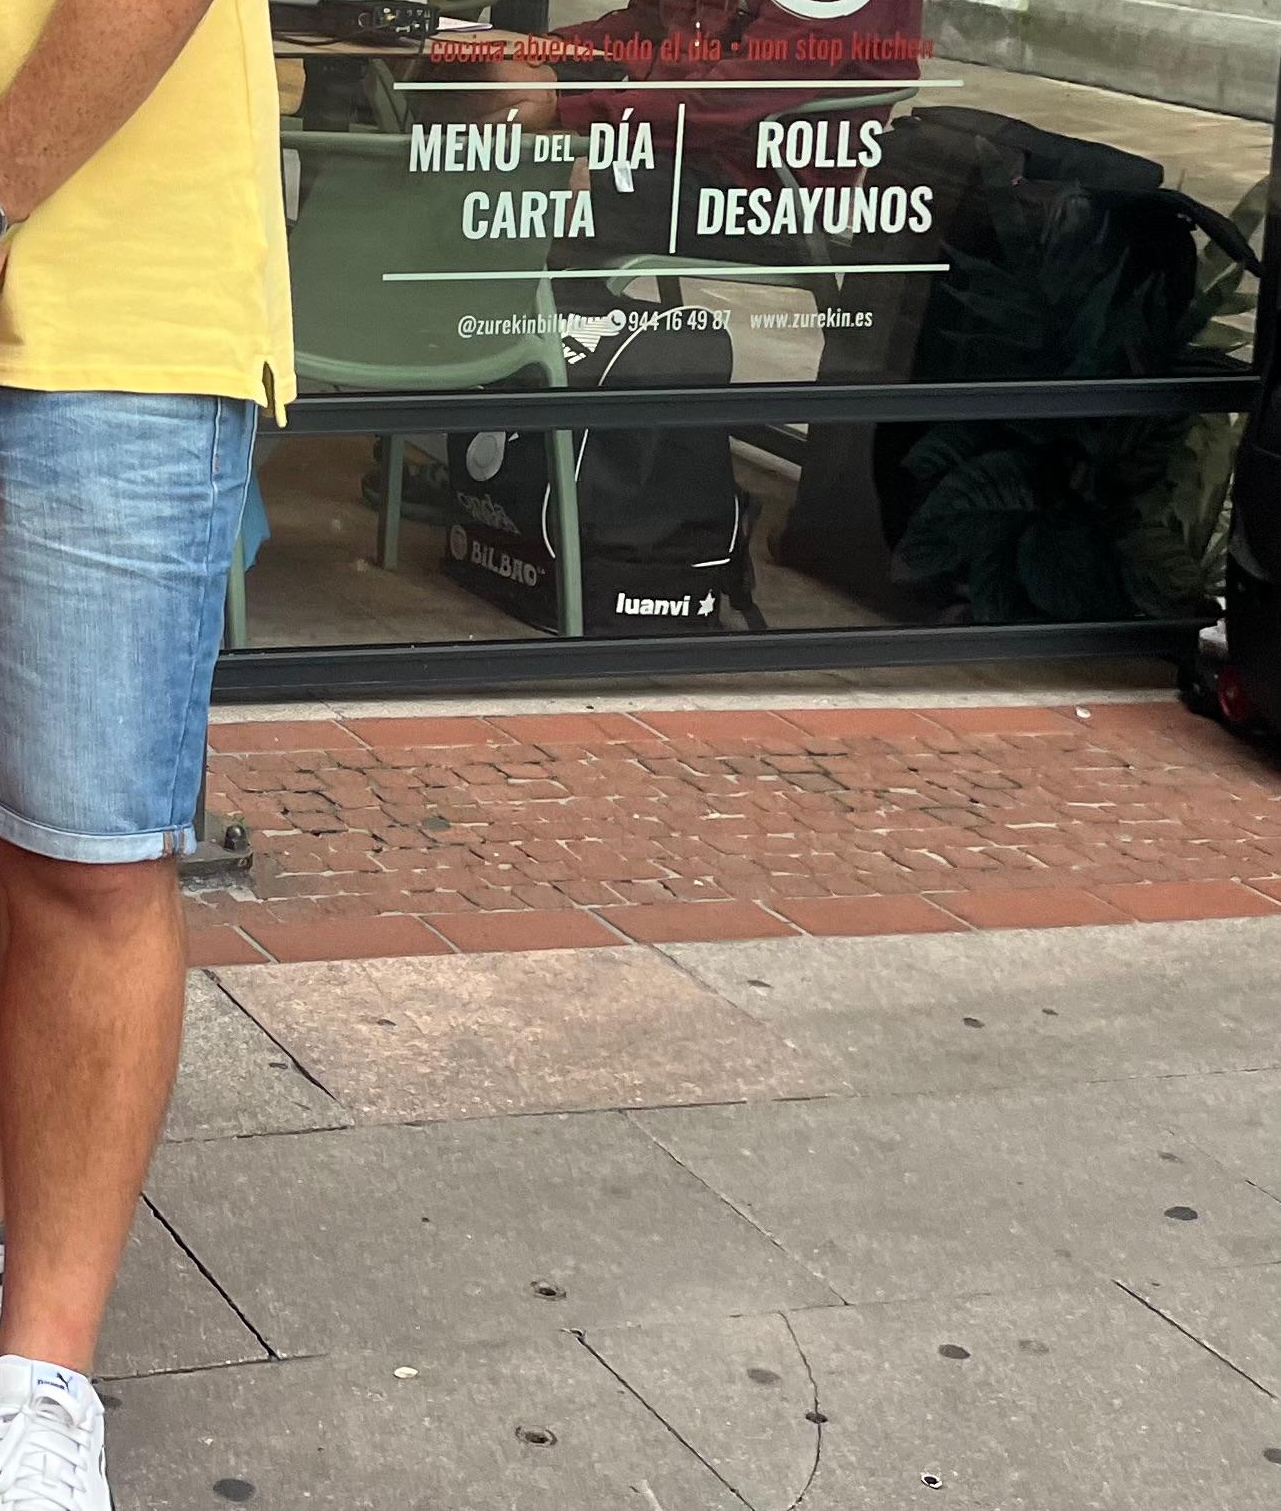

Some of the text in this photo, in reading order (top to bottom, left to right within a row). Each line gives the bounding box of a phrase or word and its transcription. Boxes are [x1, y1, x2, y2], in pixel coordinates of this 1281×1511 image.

[429, 30, 934, 68] cocina abierta todo el día non stop kitchen
[408, 107, 656, 172] MENÚ DEL DÍA
[756, 120, 883, 169] ROLLS
[462, 190, 596, 240] CARTA
[696, 185, 934, 237] DESAYUNOS
[628, 310, 658, 332] 944
[665, 310, 682, 331] 16
[687, 309, 708, 331] 49
[750, 307, 873, 330] www.zurekin.es
[615, 592, 691, 617] luanvi
